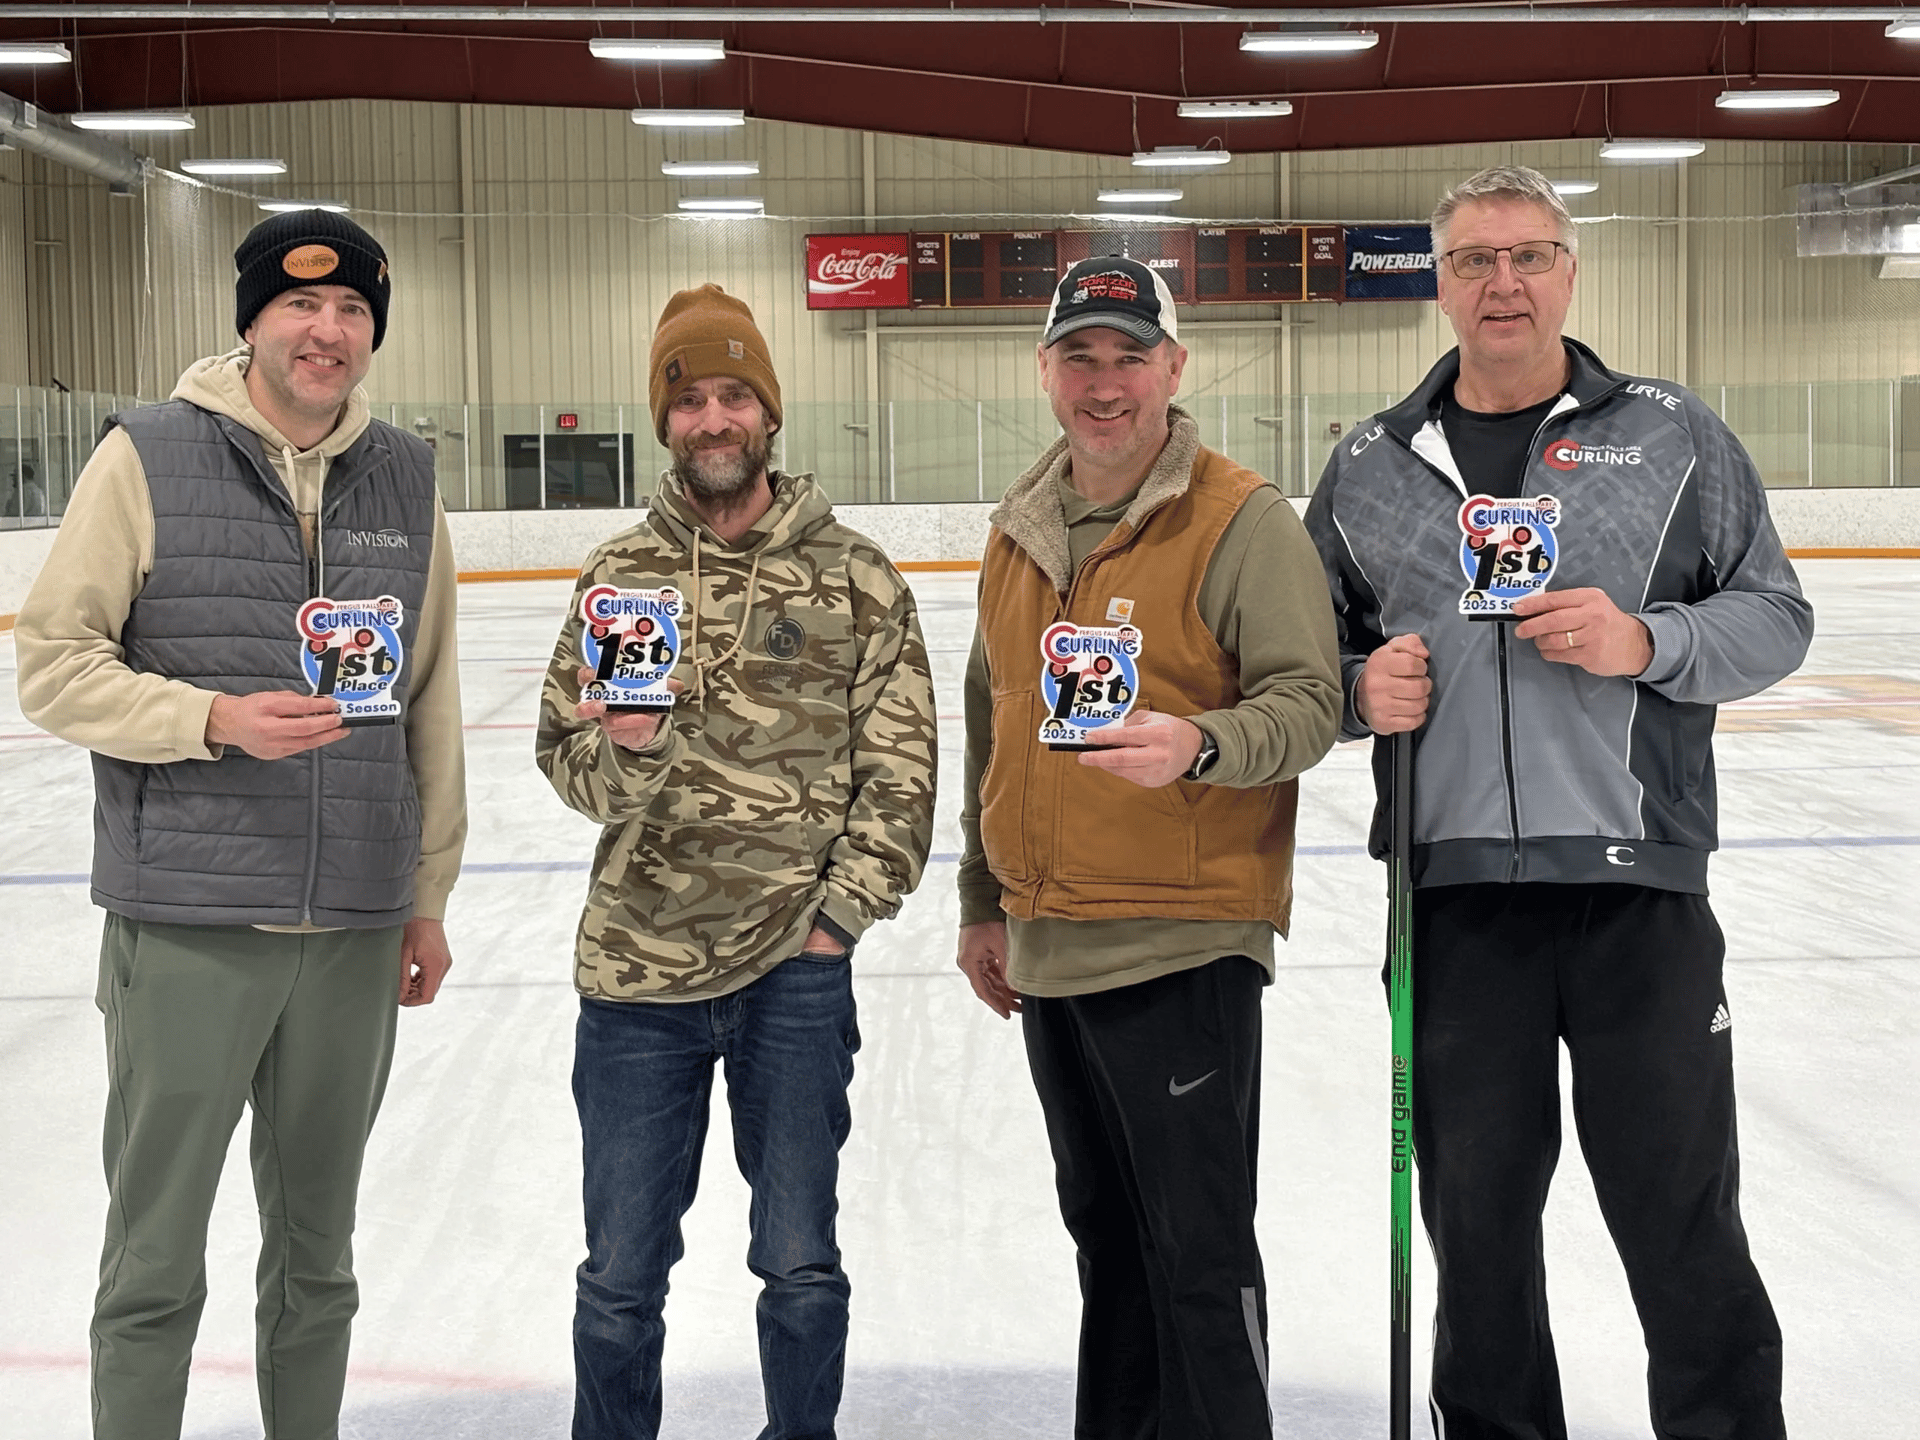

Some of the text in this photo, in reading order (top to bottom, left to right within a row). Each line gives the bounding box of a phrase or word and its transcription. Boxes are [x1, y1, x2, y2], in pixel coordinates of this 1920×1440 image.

[1259, 227, 1288, 235] PENALTY
[818, 252, 898, 280] Coca-Cola
[1149, 259, 1180, 268] GUEST
[1554, 446, 1642, 467] CURLING
[1606, 444, 1624, 452] FALLS
[1471, 507, 1558, 529] CURLING
[1472, 543, 1545, 590] 1st
[1496, 576, 1542, 588] Place
[594, 597, 681, 620] CURLING
[1463, 600, 1496, 610] 2025
[311, 609, 400, 632] CURLING
[1054, 635, 1139, 657] CURLING
[595, 636, 668, 681] 1st
[314, 646, 390, 695] 1st
[618, 666, 664, 680] Place
[340, 679, 388, 692] Place
[585, 690, 672, 702] 2025 Season
[1054, 671, 1126, 719] 1st
[346, 703, 397, 713] Season
[1076, 705, 1121, 719] Place
[1043, 729, 1076, 739] 2025
[1391, 1054, 1410, 1173] end game
